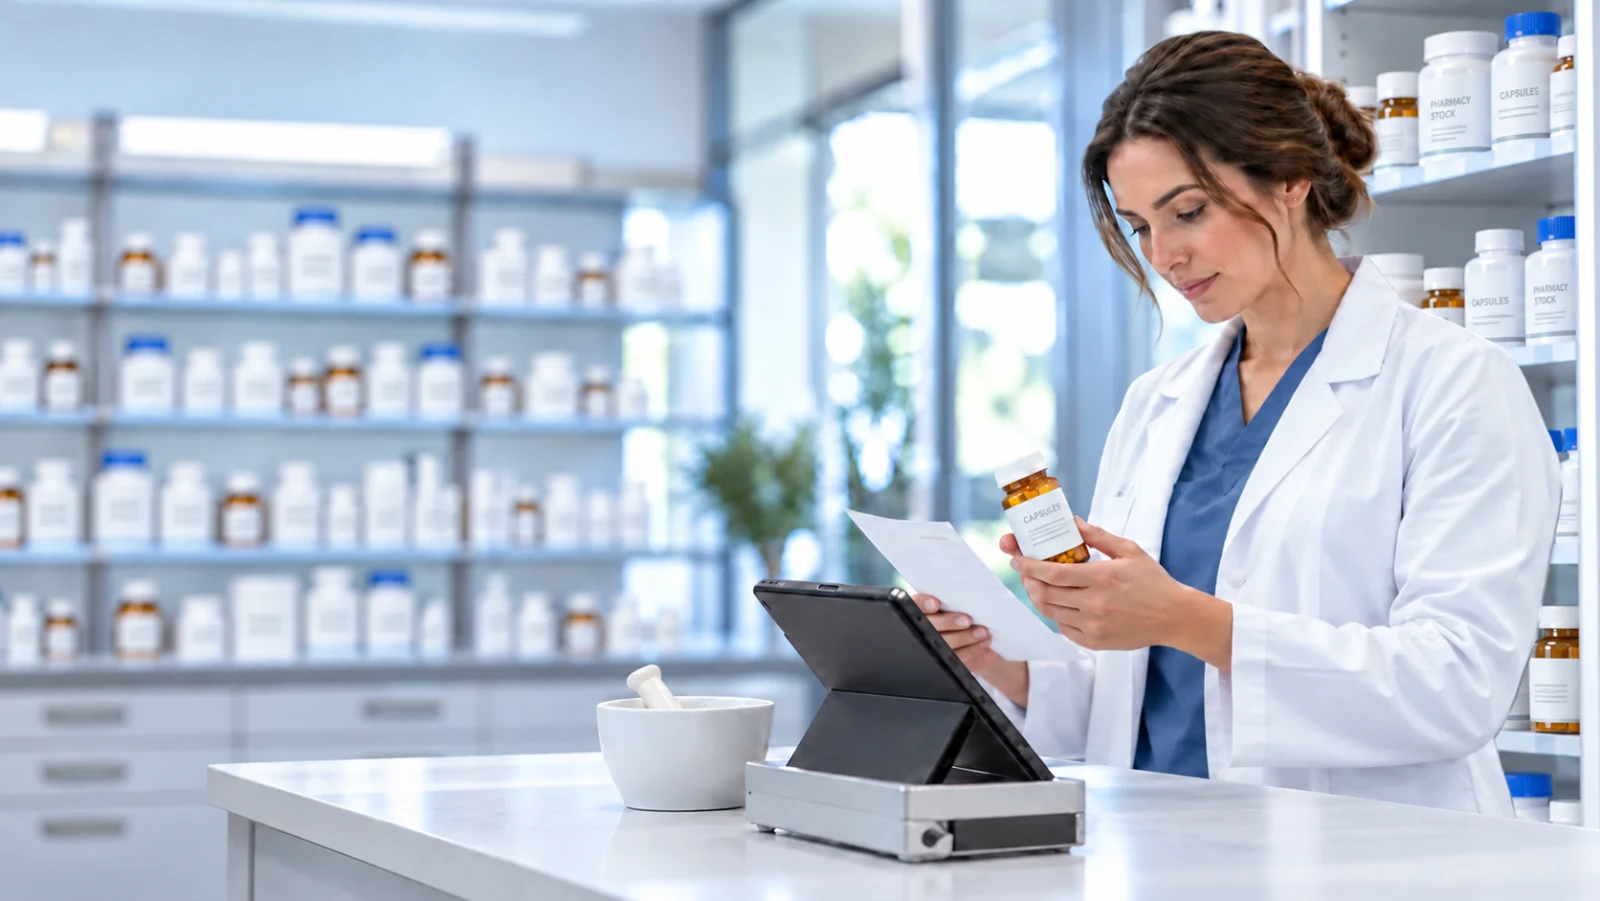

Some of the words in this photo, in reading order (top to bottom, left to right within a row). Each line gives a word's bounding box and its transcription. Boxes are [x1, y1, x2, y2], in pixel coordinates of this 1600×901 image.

[1499, 86, 1540, 100] CAPSULES
[1430, 95, 1471, 109] PHARMACY
[1430, 108, 1456, 121] STOCK
[1533, 283, 1569, 295] PHARMACY
[1471, 296, 1510, 307] CAPSULES
[1534, 295, 1557, 306] STOCK
[1023, 502, 1062, 524] CAPSULES
